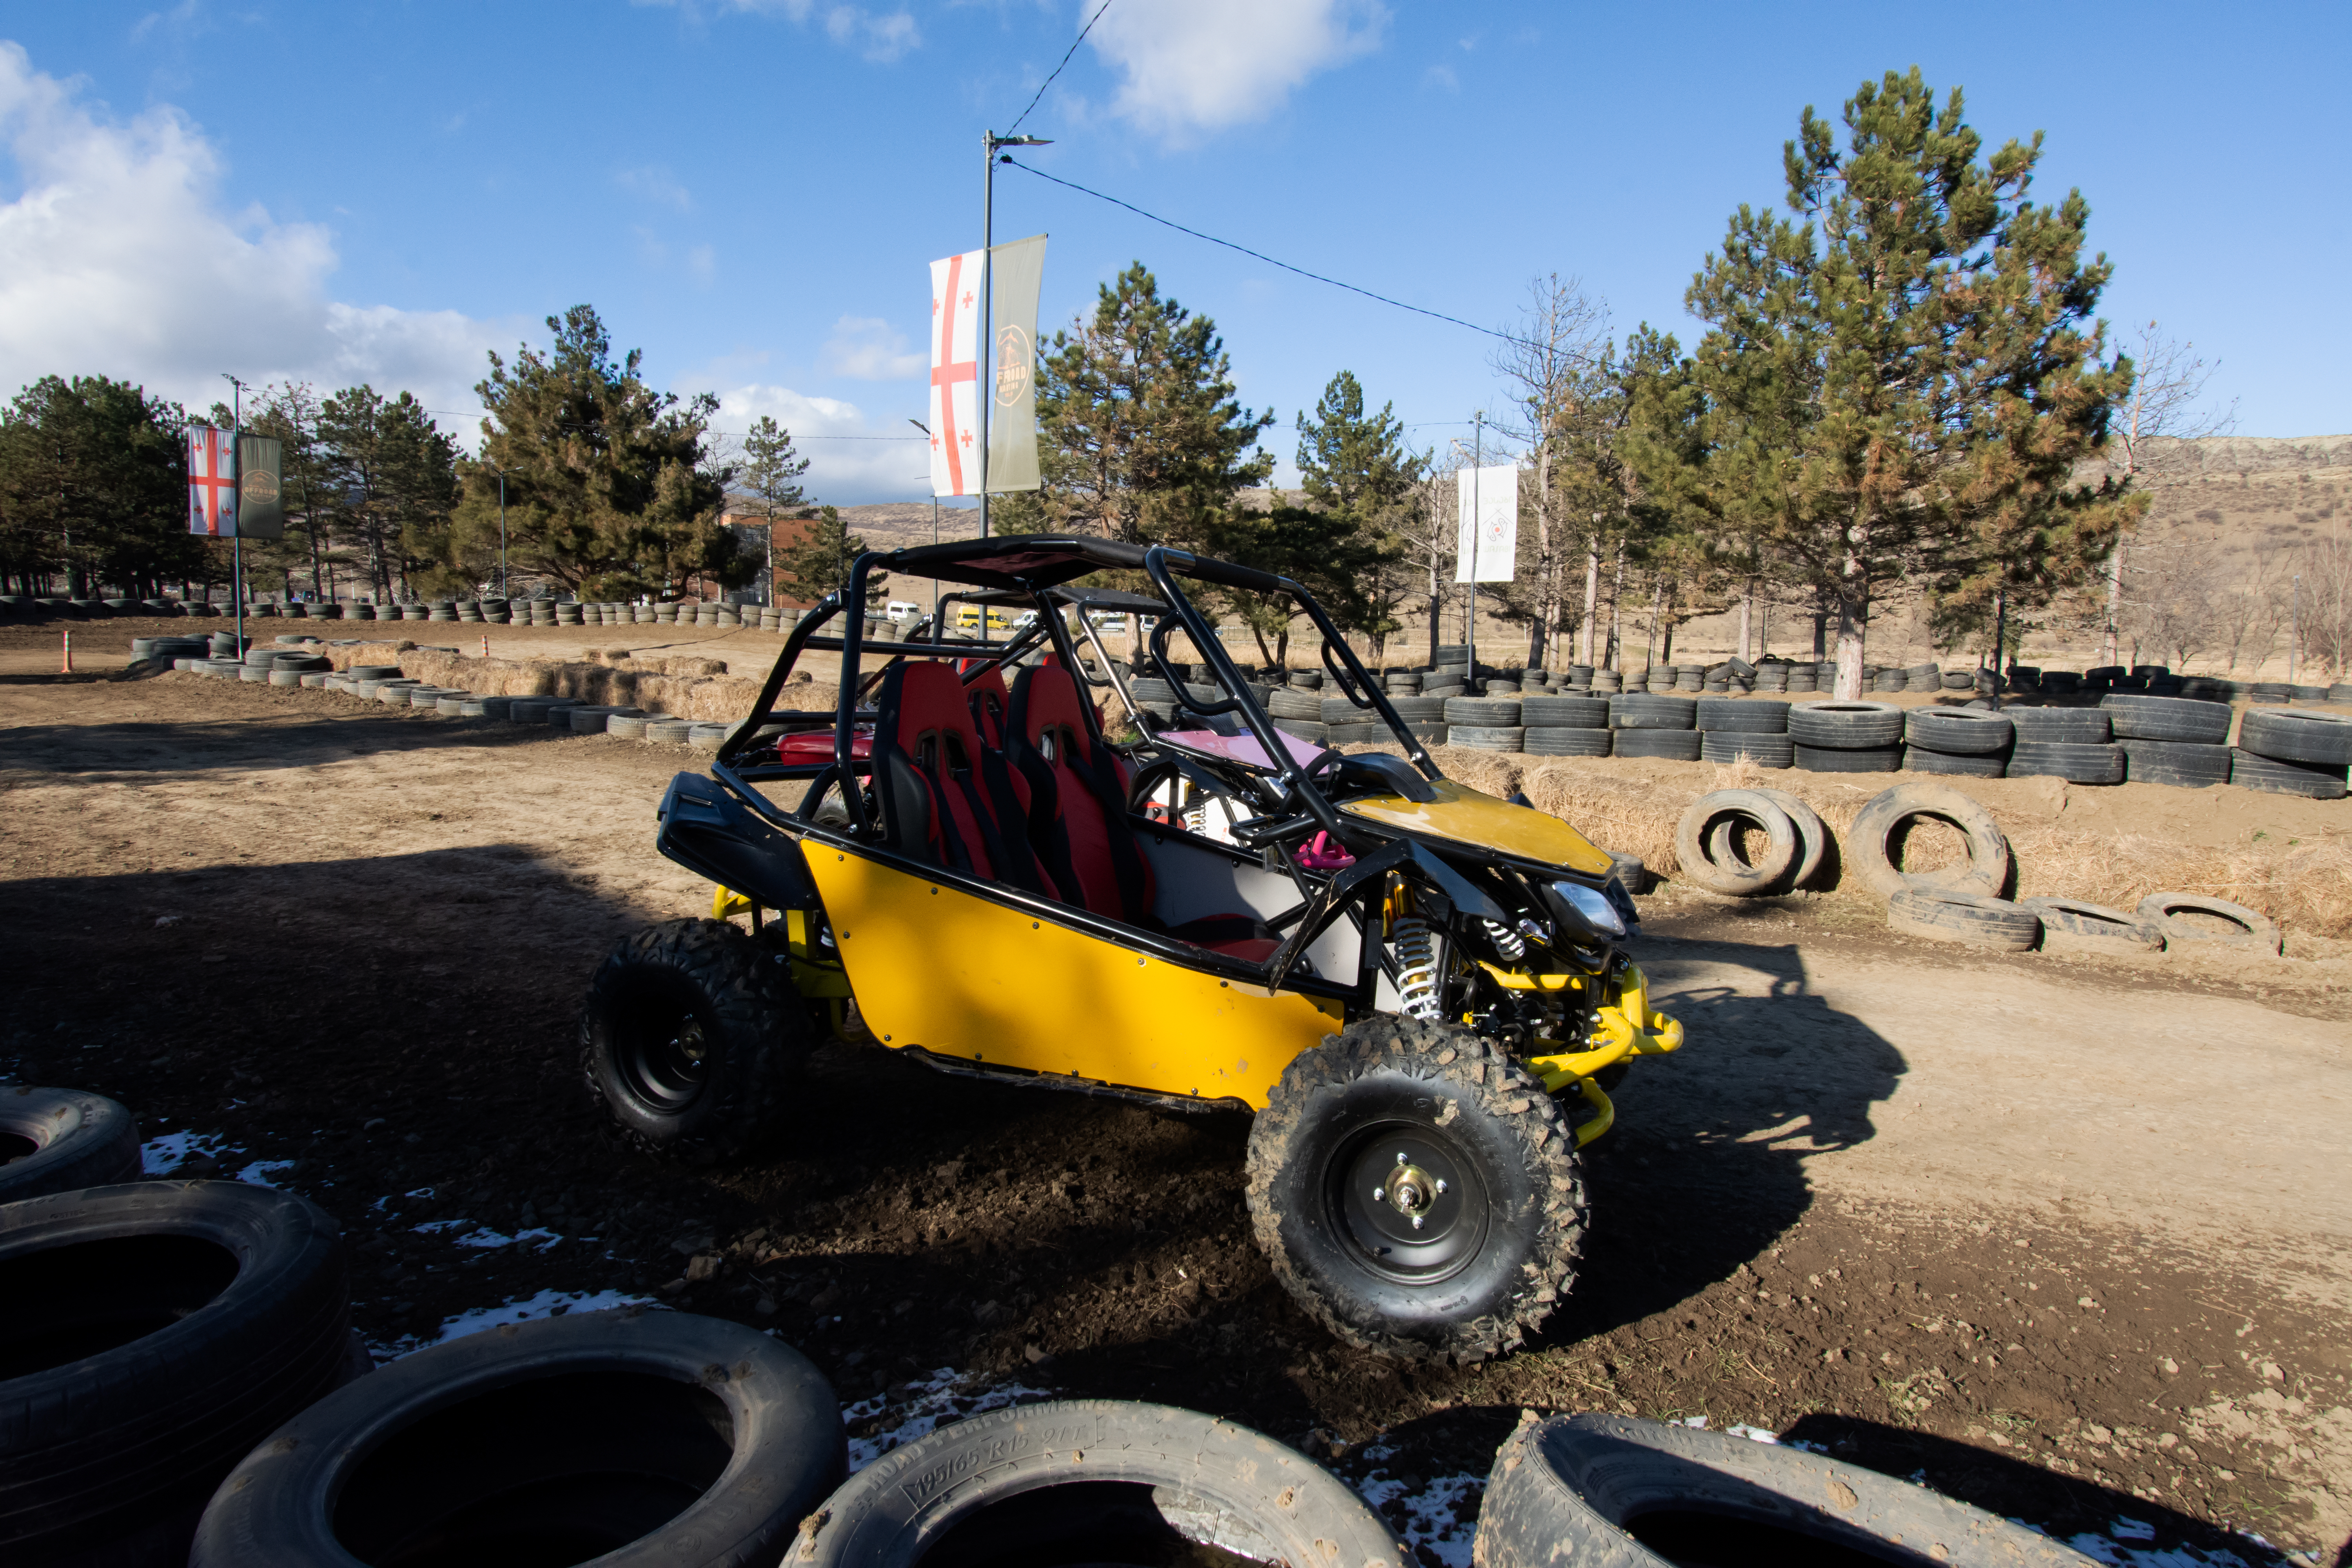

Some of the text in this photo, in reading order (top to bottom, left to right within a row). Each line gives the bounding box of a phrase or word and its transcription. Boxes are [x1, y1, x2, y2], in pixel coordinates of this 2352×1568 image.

[244, 487, 278, 495] OFFROAD
[866, 1443, 927, 1490] ROAD
[914, 1423, 1086, 1497] 195/65 R15 91T
